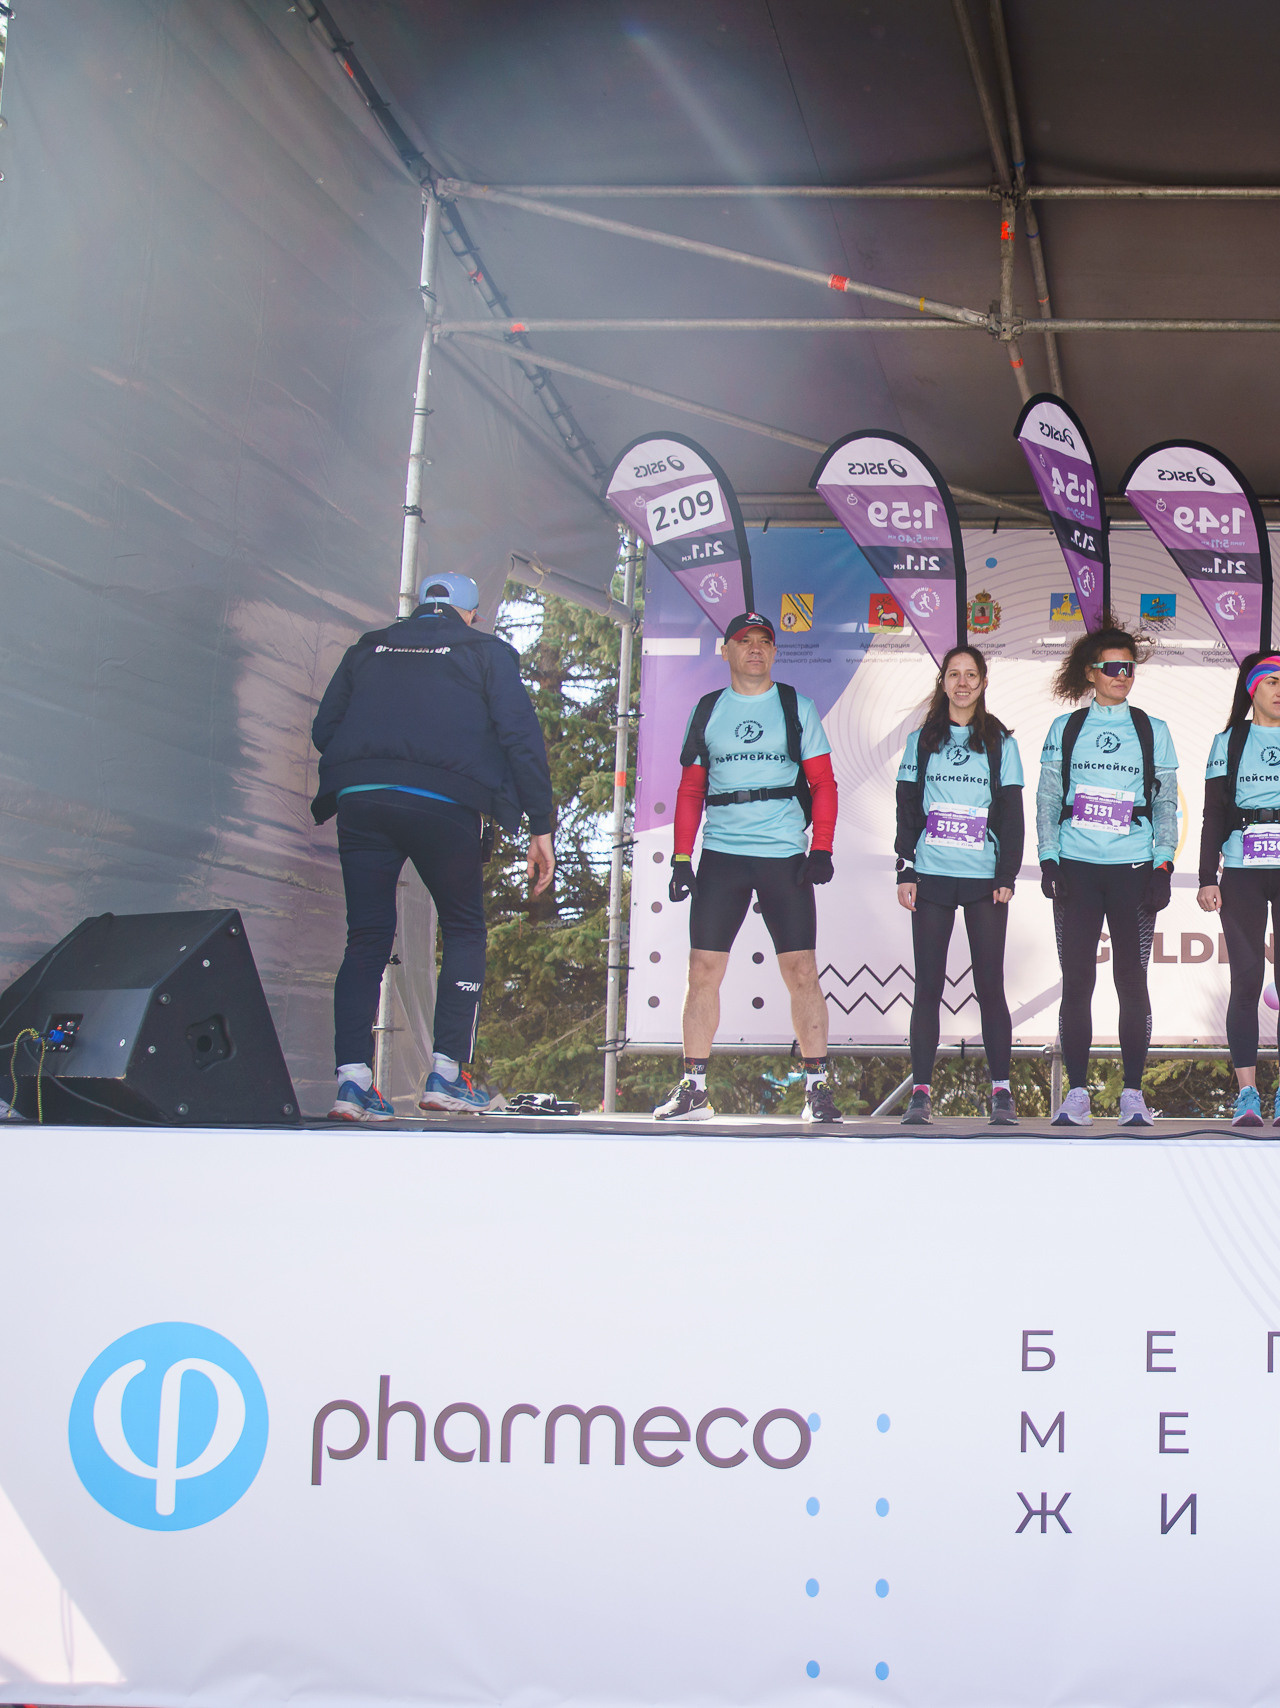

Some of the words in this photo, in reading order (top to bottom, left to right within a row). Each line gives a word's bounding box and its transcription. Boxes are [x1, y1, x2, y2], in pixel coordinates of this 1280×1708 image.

[652, 490, 714, 532] 2:09
[1072, 760, 1140, 775] пейсмейкер
[1084, 803, 1113, 818] 5131
[936, 819, 968, 834] 5132
[311, 1374, 813, 1486] pharmeco
